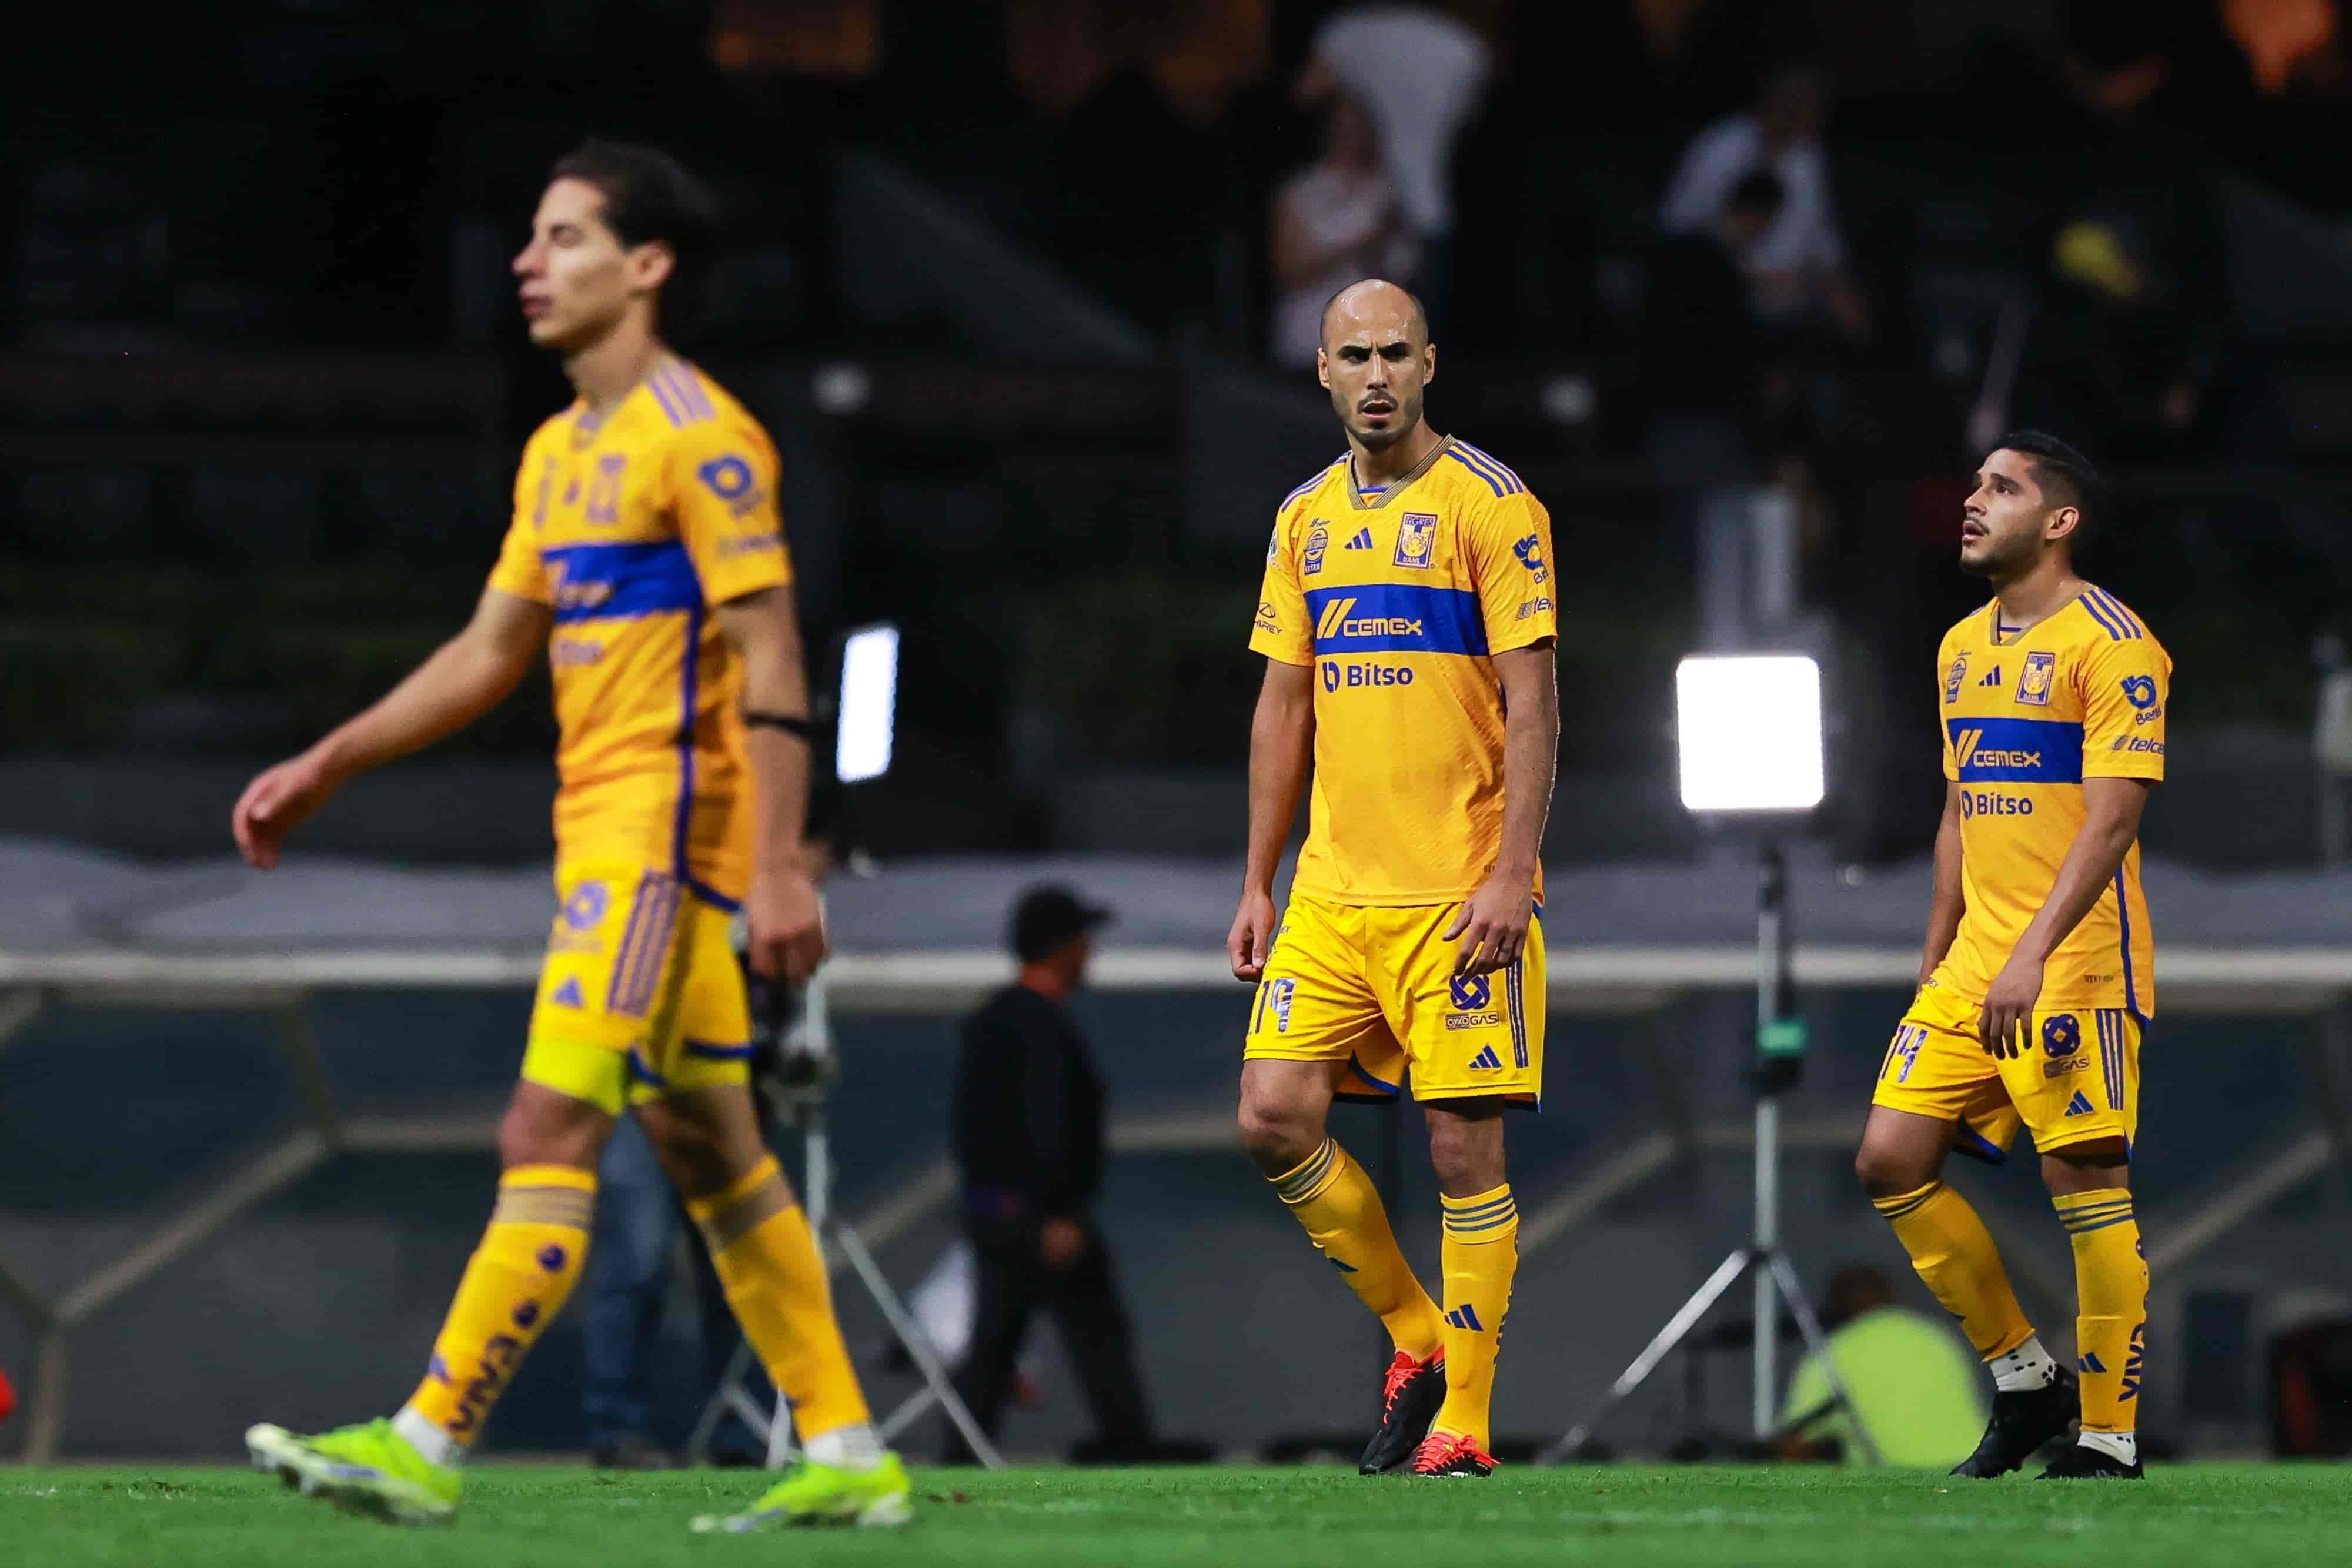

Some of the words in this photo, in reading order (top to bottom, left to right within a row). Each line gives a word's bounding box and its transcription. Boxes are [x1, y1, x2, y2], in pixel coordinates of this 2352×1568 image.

[1343, 617, 1423, 637] CEMEX
[1347, 662, 1414, 687] Bitso
[1973, 750, 2042, 768] CEMEX
[1976, 791, 2033, 815] Bitso
[1255, 978, 1294, 1033] 19
[1880, 1025, 1929, 1083] 14
